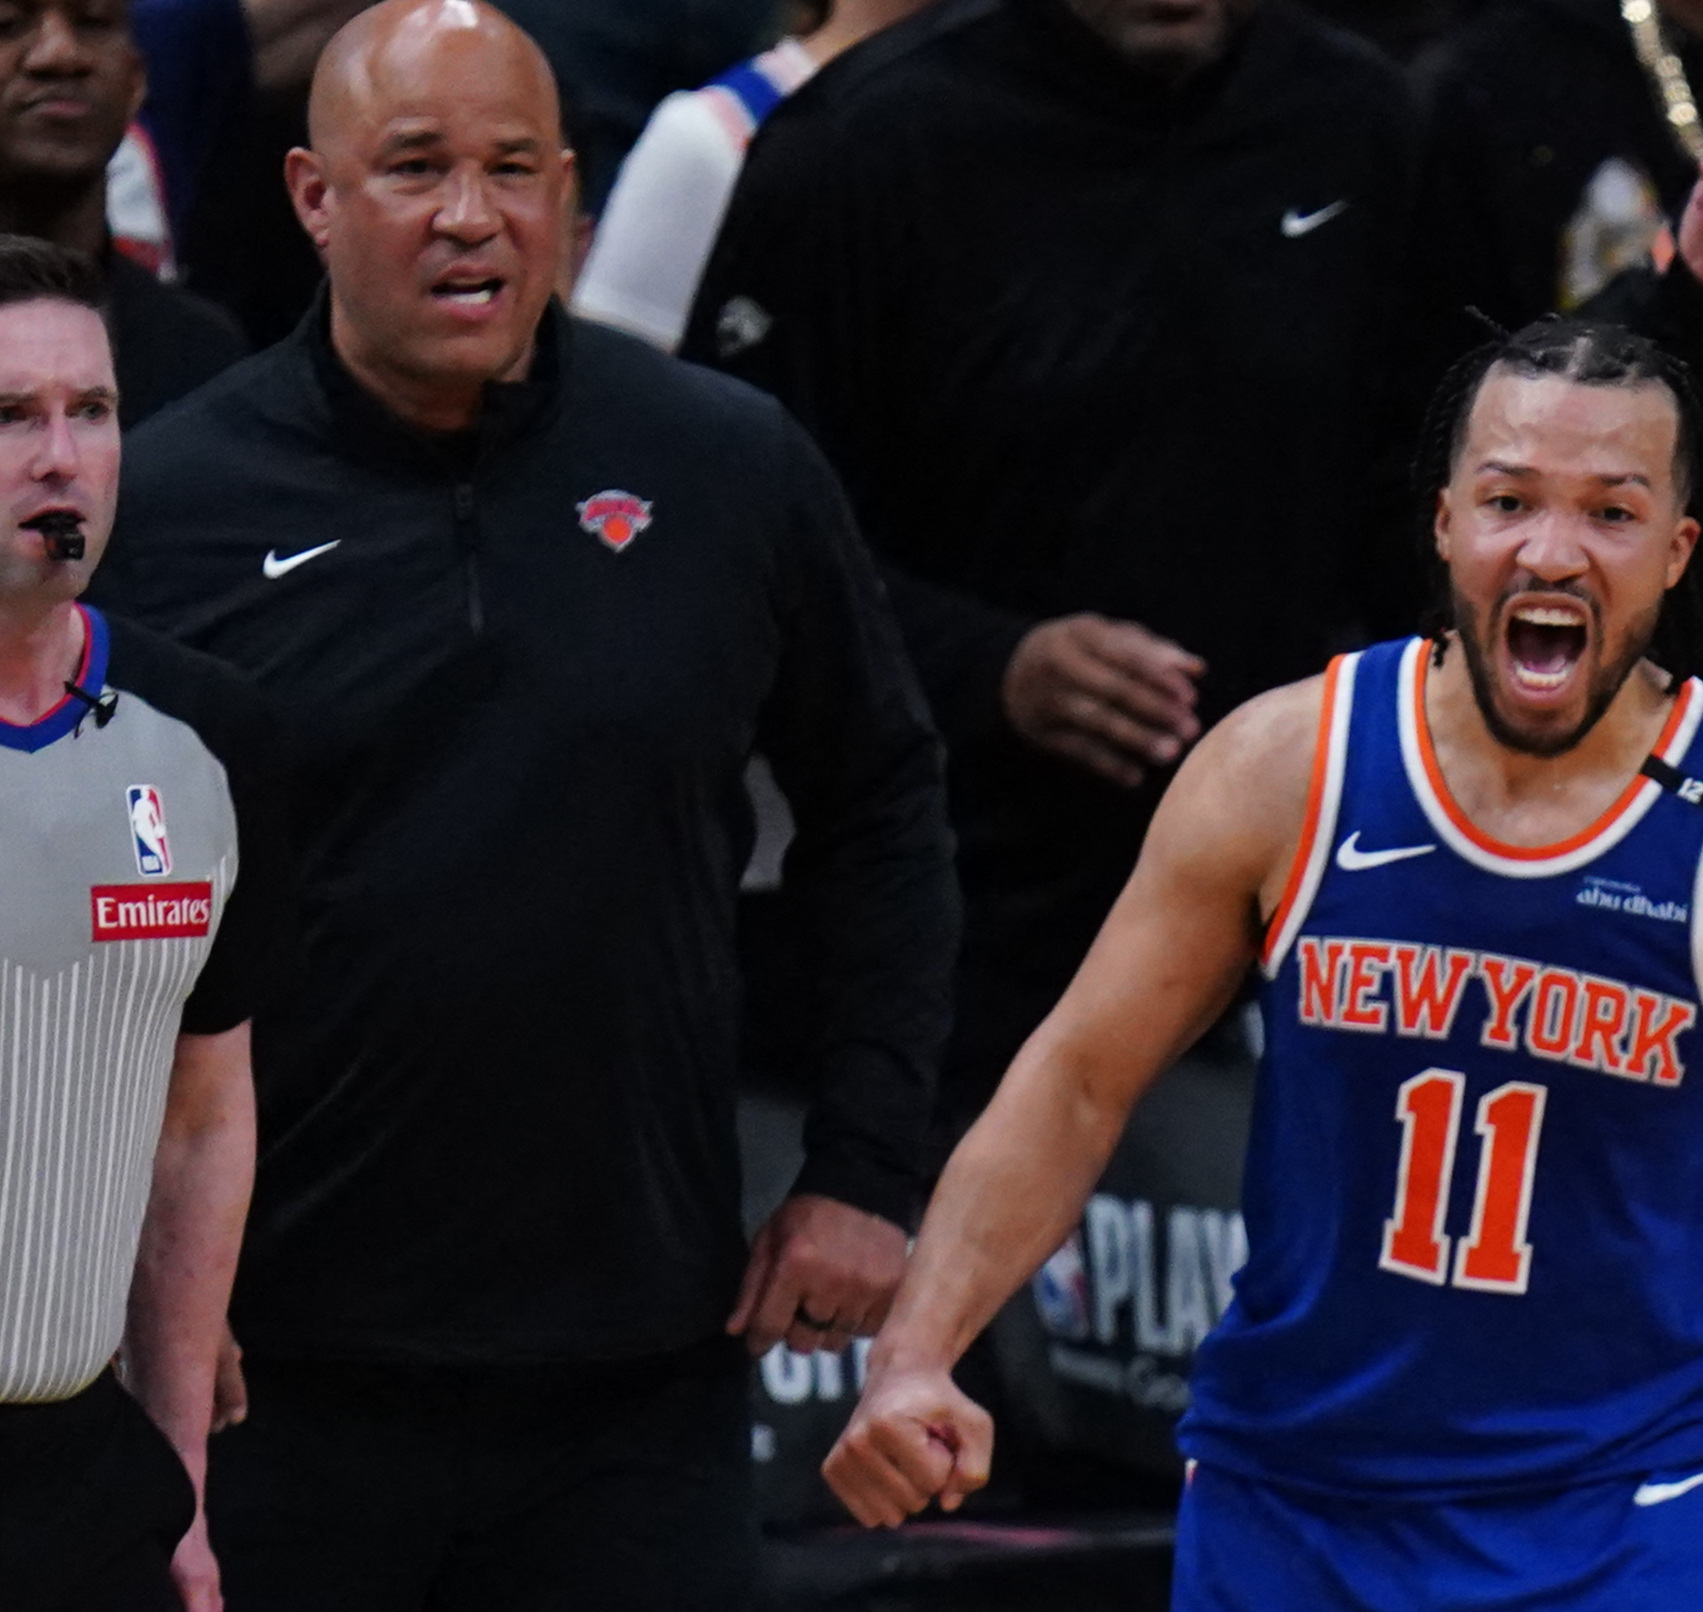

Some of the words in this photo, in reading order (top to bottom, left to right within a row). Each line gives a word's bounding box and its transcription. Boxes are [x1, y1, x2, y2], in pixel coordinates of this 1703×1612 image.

[96, 893, 210, 929] Emirates
[1297, 936, 1475, 1040] NEW
[1480, 952, 1697, 1088] YORK
[1380, 1066, 1547, 1294] 11
